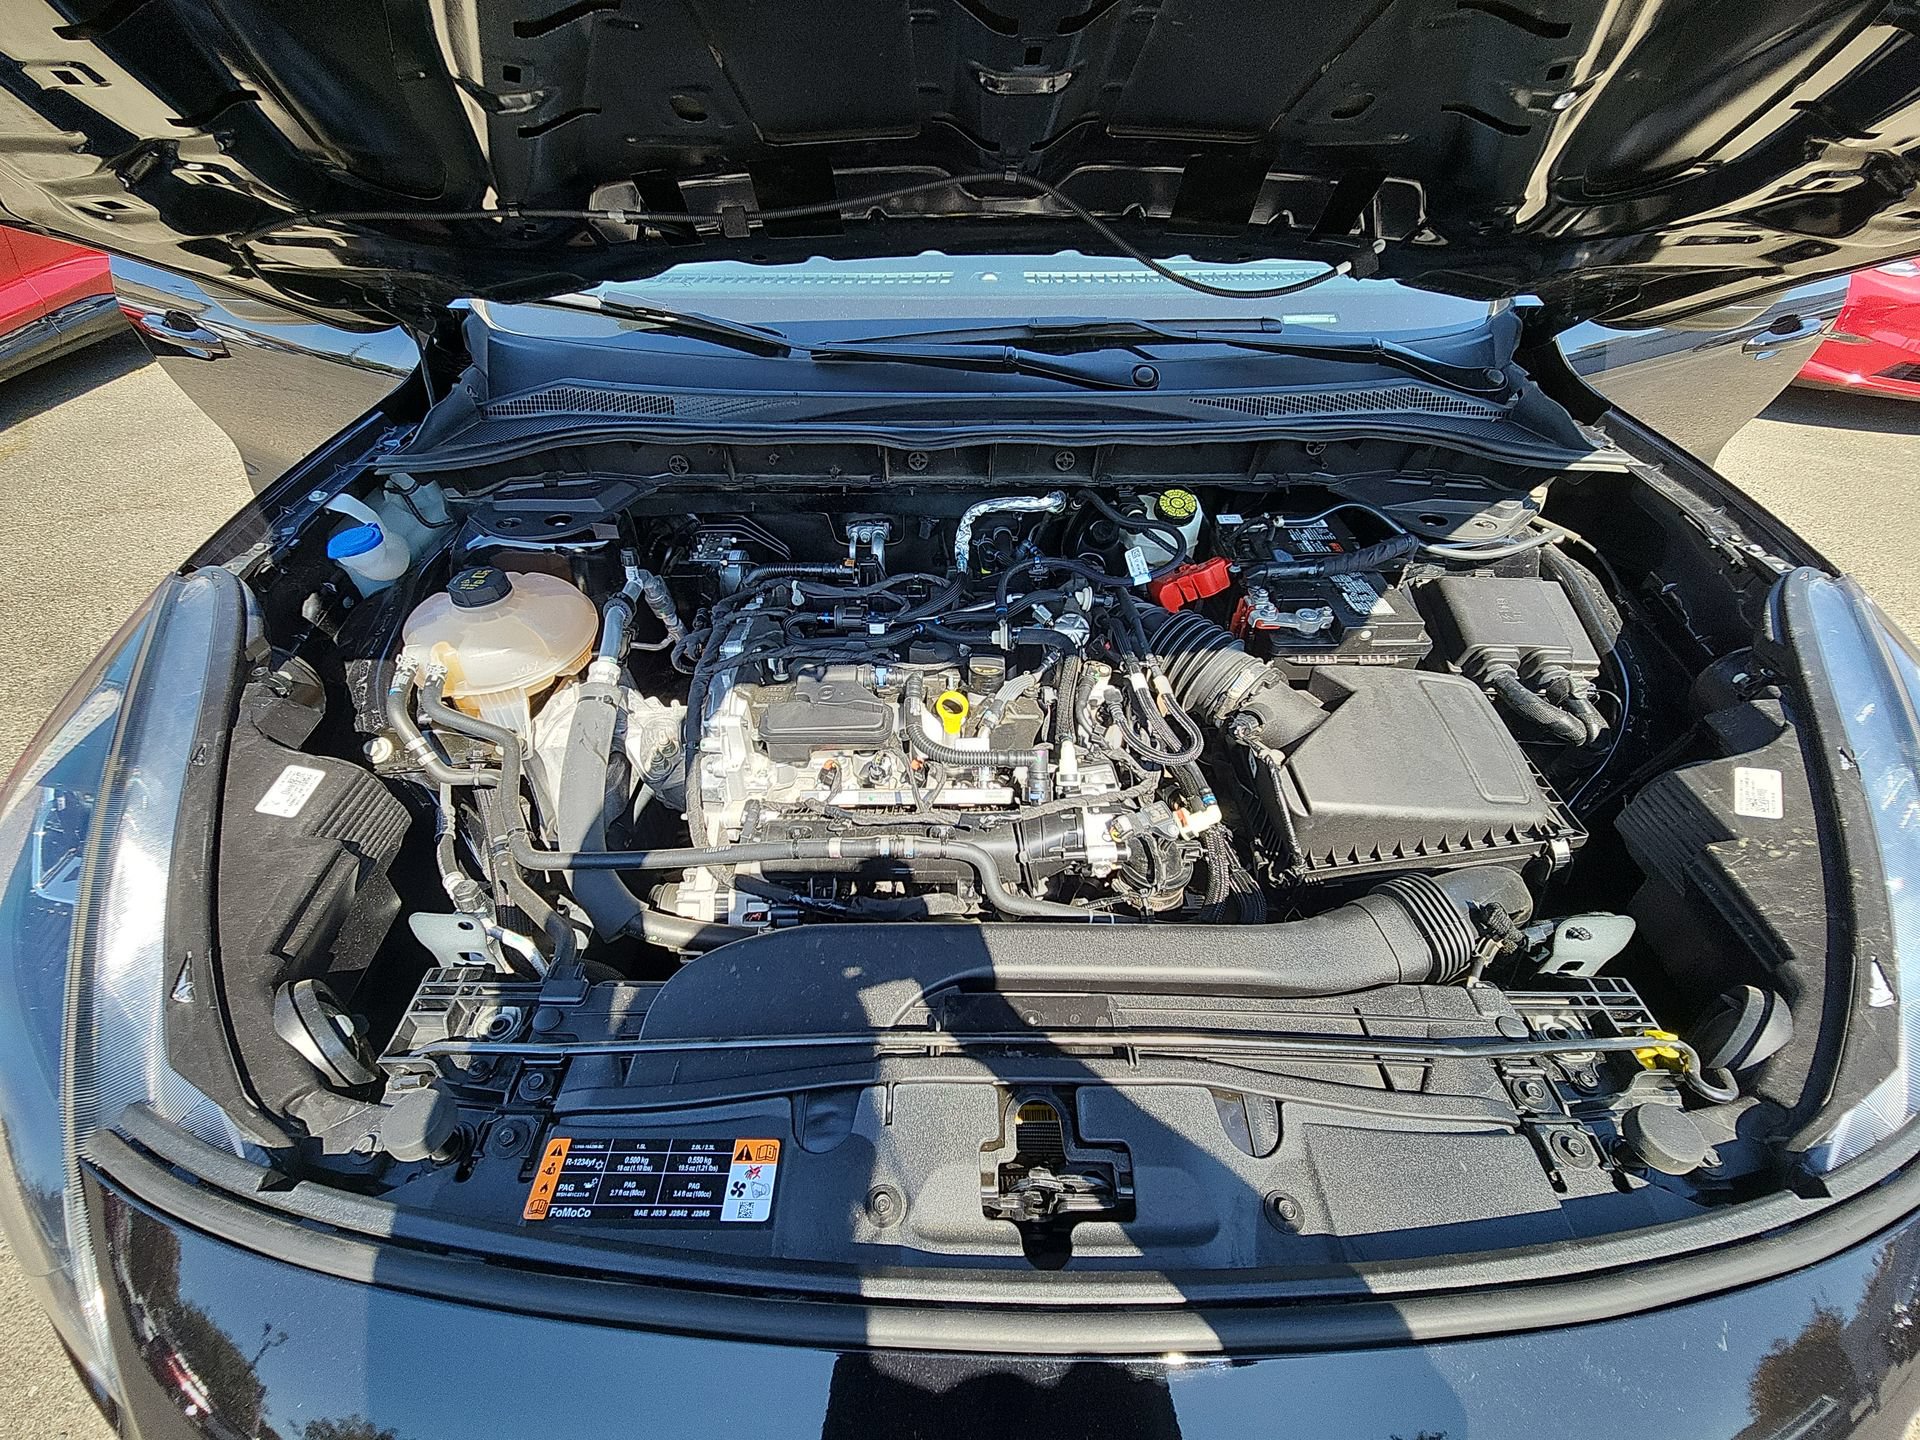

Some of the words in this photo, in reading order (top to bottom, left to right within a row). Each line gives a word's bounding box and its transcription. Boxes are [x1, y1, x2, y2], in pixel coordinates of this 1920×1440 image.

[565, 1158, 597, 1167] R-1234yf
[624, 1156, 641, 1164] 0.500
[641, 1157, 650, 1165] kg
[687, 1156, 704, 1164] 0.550
[703, 1156, 712, 1165] kg
[695, 1165, 709, 1173] (1.21
[549, 1207, 592, 1218] FoMoCo
